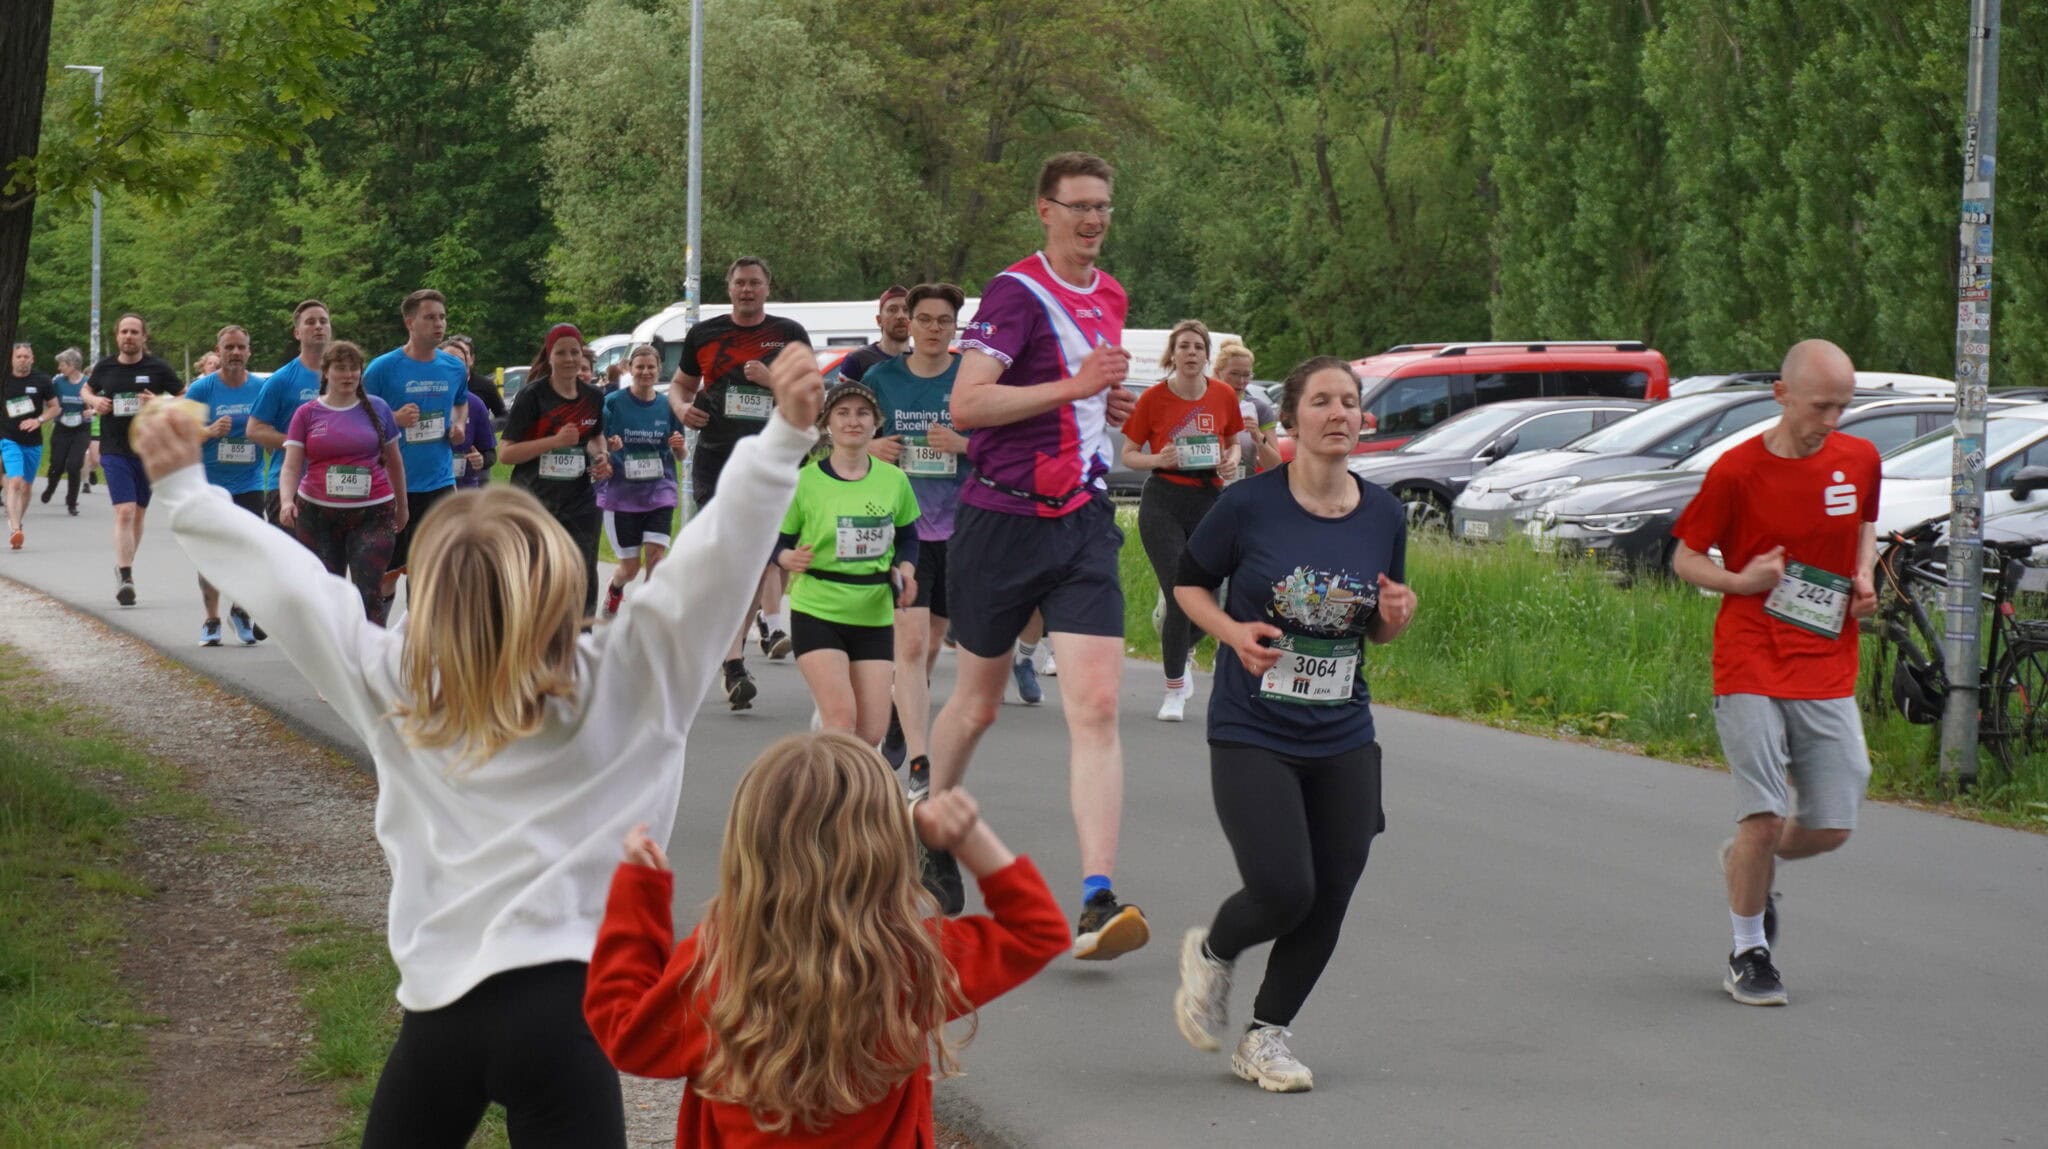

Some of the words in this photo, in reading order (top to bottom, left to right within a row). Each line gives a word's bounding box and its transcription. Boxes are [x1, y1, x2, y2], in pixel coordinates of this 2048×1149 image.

[740, 394, 761, 406] 1053
[895, 409, 938, 423] Running
[940, 410, 952, 420] fo
[624, 428, 654, 438] Running
[231, 444, 246, 453] 855
[916, 448, 942, 460] 1890
[1191, 444, 1212, 455] 1709
[553, 455, 574, 465] 1057
[341, 474, 358, 485] 246
[856, 528, 883, 542] 3454
[1797, 583, 1834, 606] 2424
[1294, 656, 1337, 677] 3064
[1313, 687, 1331, 695] JENA
